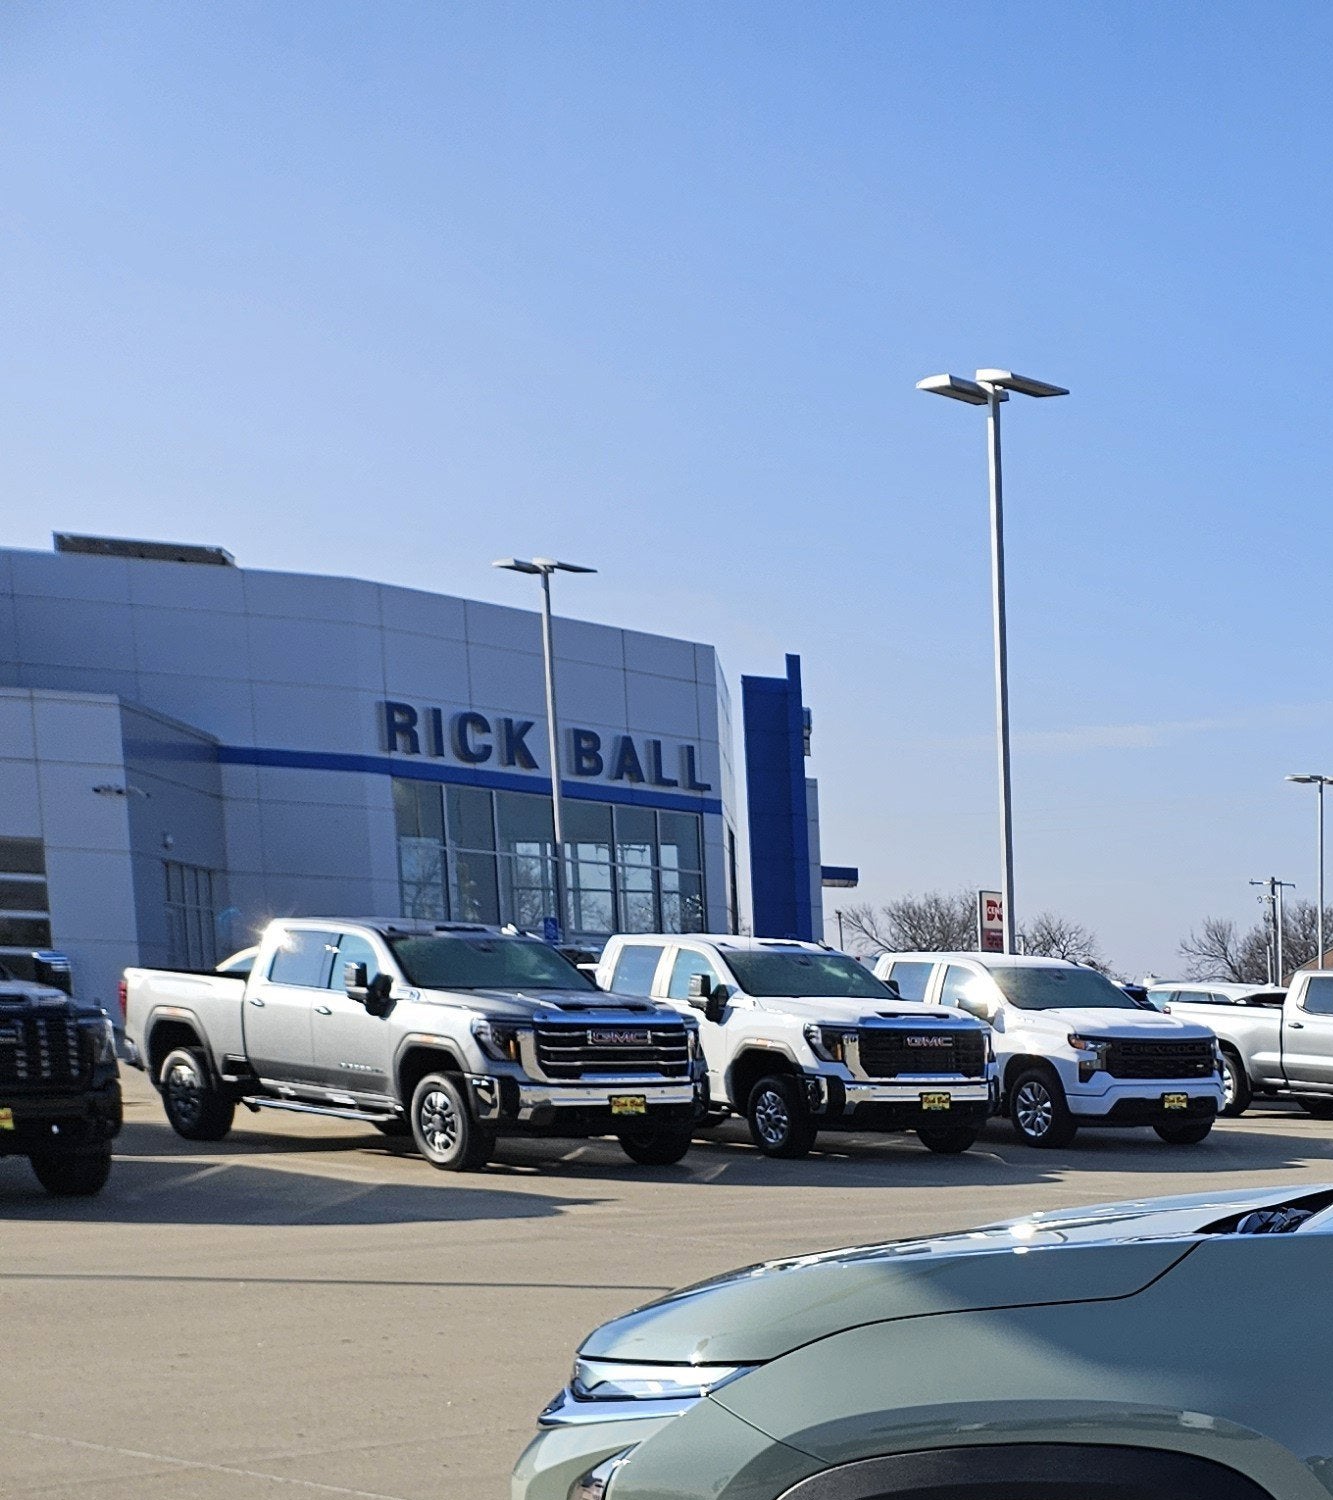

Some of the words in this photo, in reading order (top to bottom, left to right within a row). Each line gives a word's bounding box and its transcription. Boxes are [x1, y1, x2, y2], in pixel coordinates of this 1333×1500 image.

[378, 701, 540, 769] RICK
[567, 727, 712, 792] BALL
[591, 1031, 647, 1042] GMC
[906, 1036, 954, 1047] GMC
